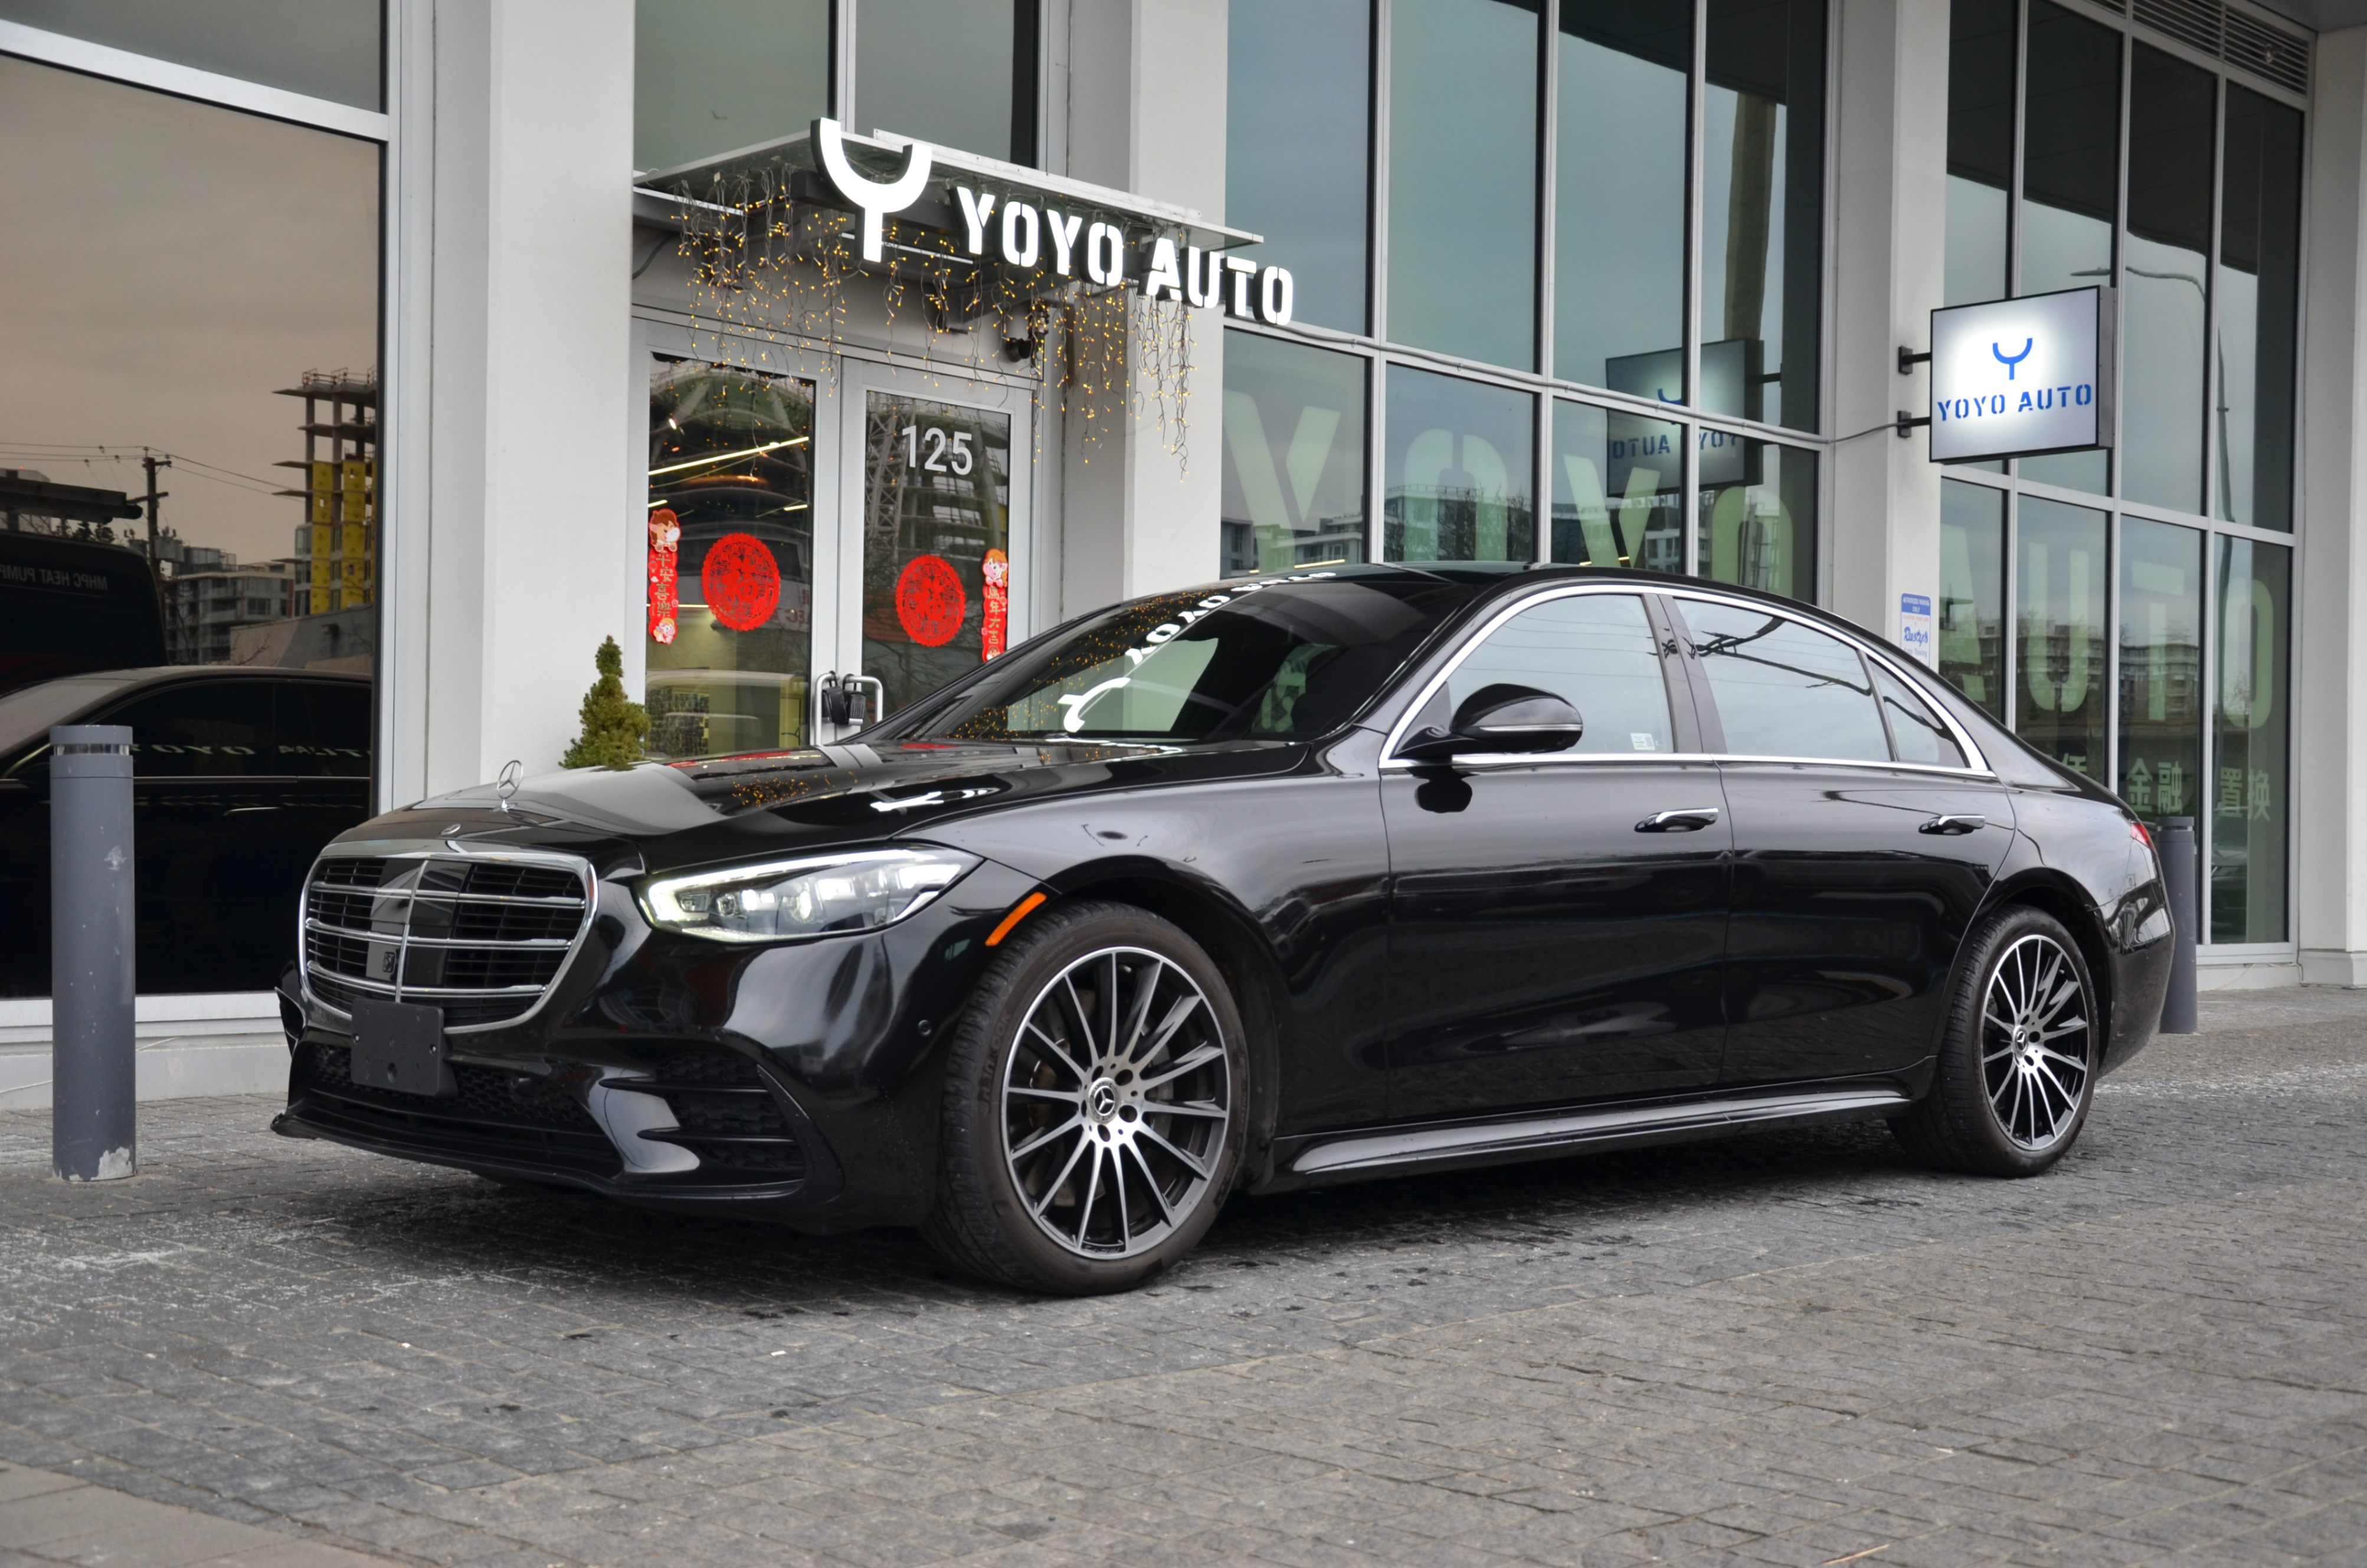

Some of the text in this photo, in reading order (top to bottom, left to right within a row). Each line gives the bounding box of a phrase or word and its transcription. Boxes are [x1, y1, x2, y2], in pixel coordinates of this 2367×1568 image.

[954, 185, 1294, 326] YOYO AUTO
[1937, 384, 2091, 421] YOYO AUTO
[902, 425, 973, 476] 125
[2126, 757, 2183, 815] 金融
[2219, 767, 2271, 821] 置换
